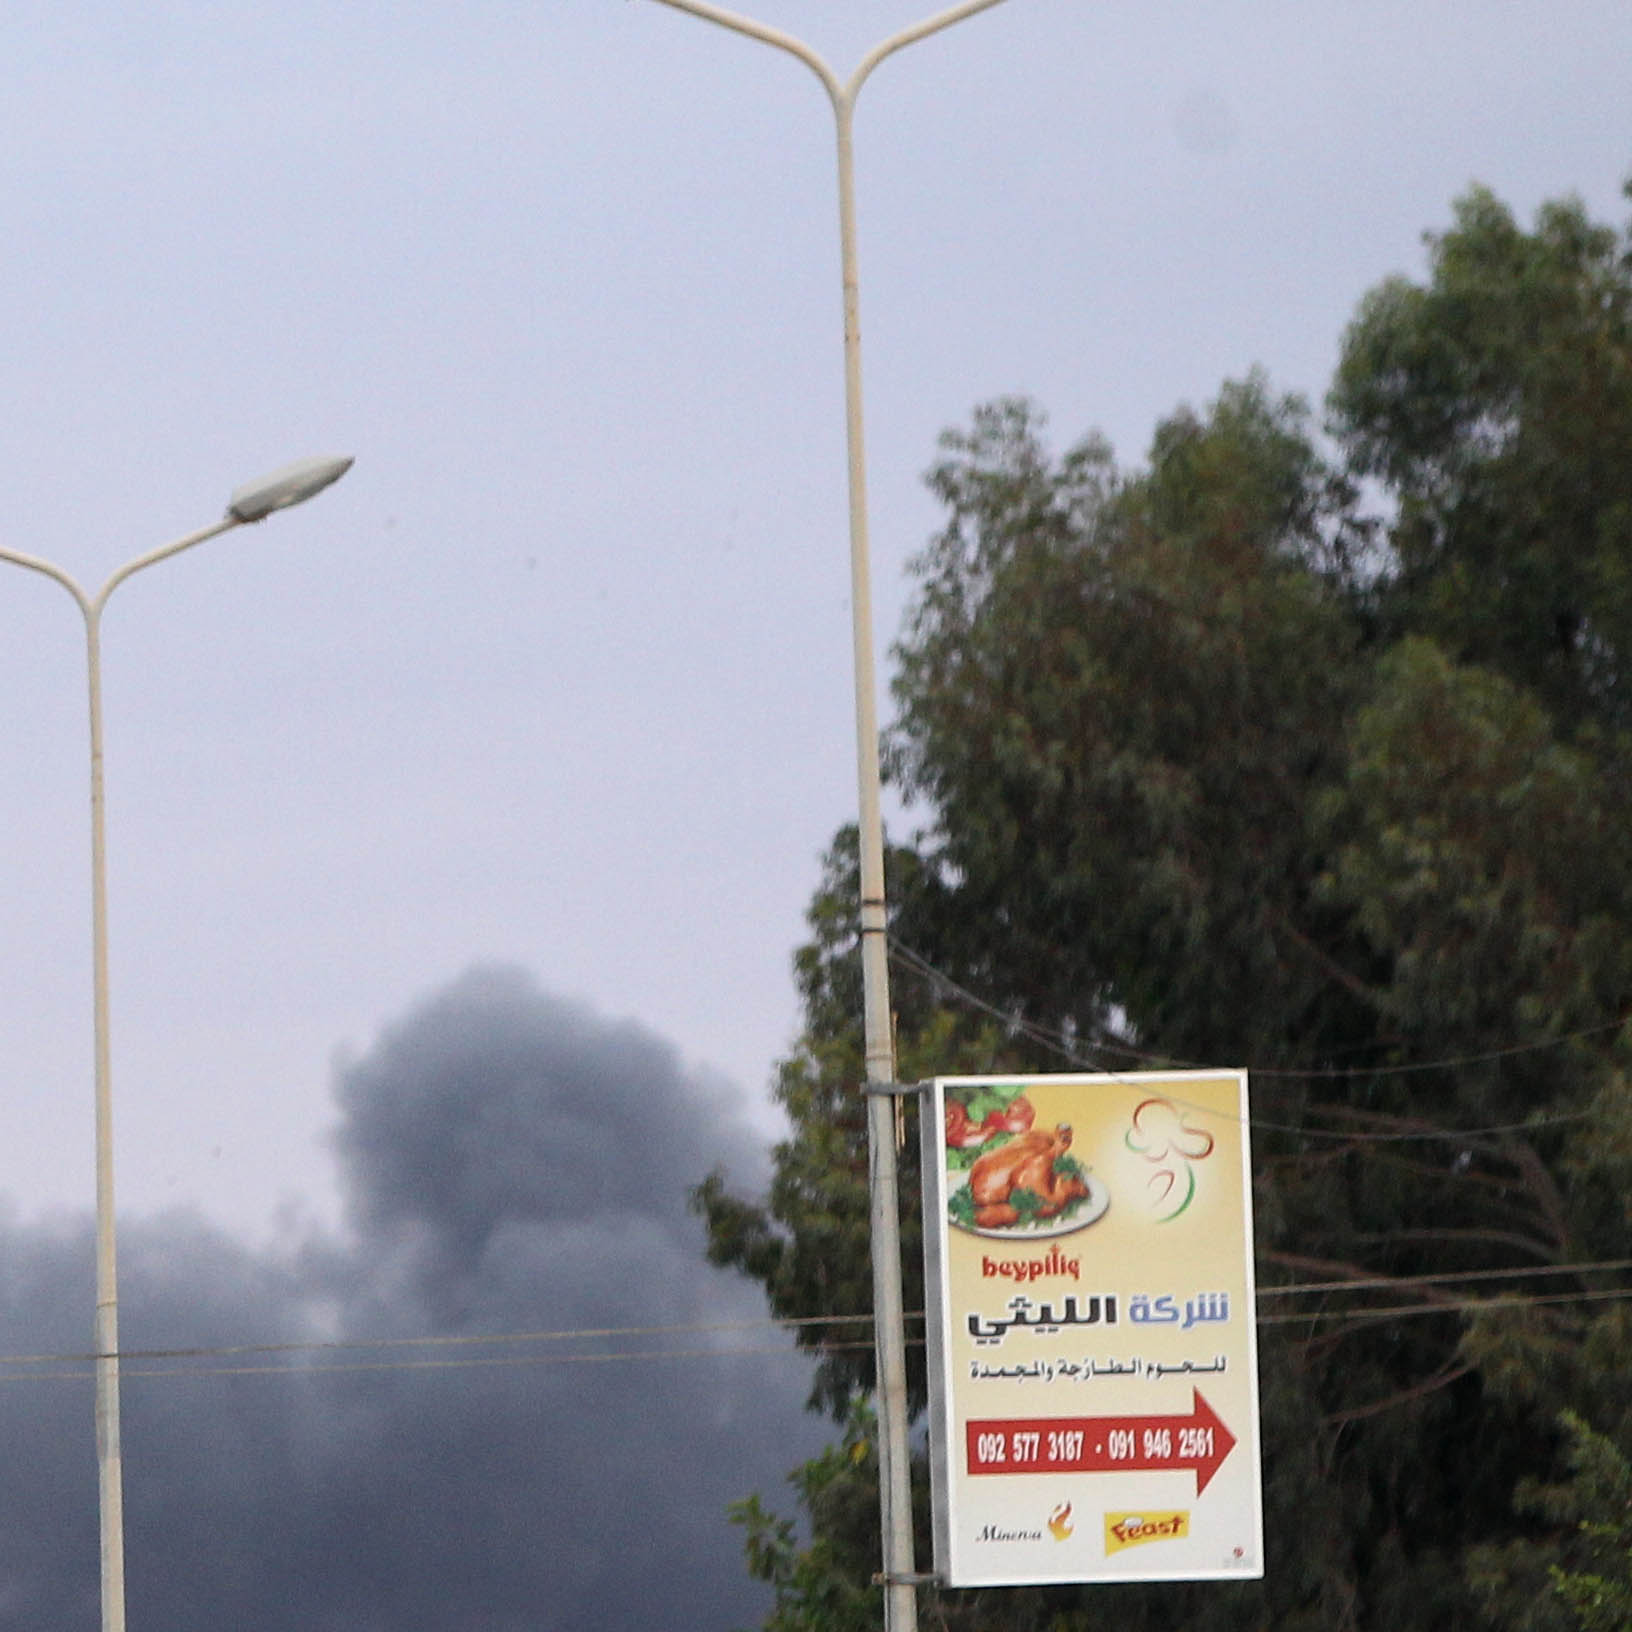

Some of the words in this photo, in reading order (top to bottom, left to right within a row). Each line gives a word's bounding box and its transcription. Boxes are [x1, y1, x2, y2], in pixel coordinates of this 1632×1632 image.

[968, 1296, 1118, 1345] الليثي
[1129, 1292, 1229, 1330] شركة
[970, 1359, 1053, 1383] والمجمدة
[1057, 1356, 1141, 1382] الطازجة
[1146, 1355, 1227, 1379] للحوم
[977, 1433, 1006, 1463] 092
[1013, 1431, 1040, 1461] 577
[1048, 1430, 1084, 1461] 3187
[1108, 1429, 1135, 1460] 091
[1143, 1429, 1171, 1459] 946
[1178, 1427, 1214, 1459] 2561
[1111, 1515, 1184, 1544] Feast
